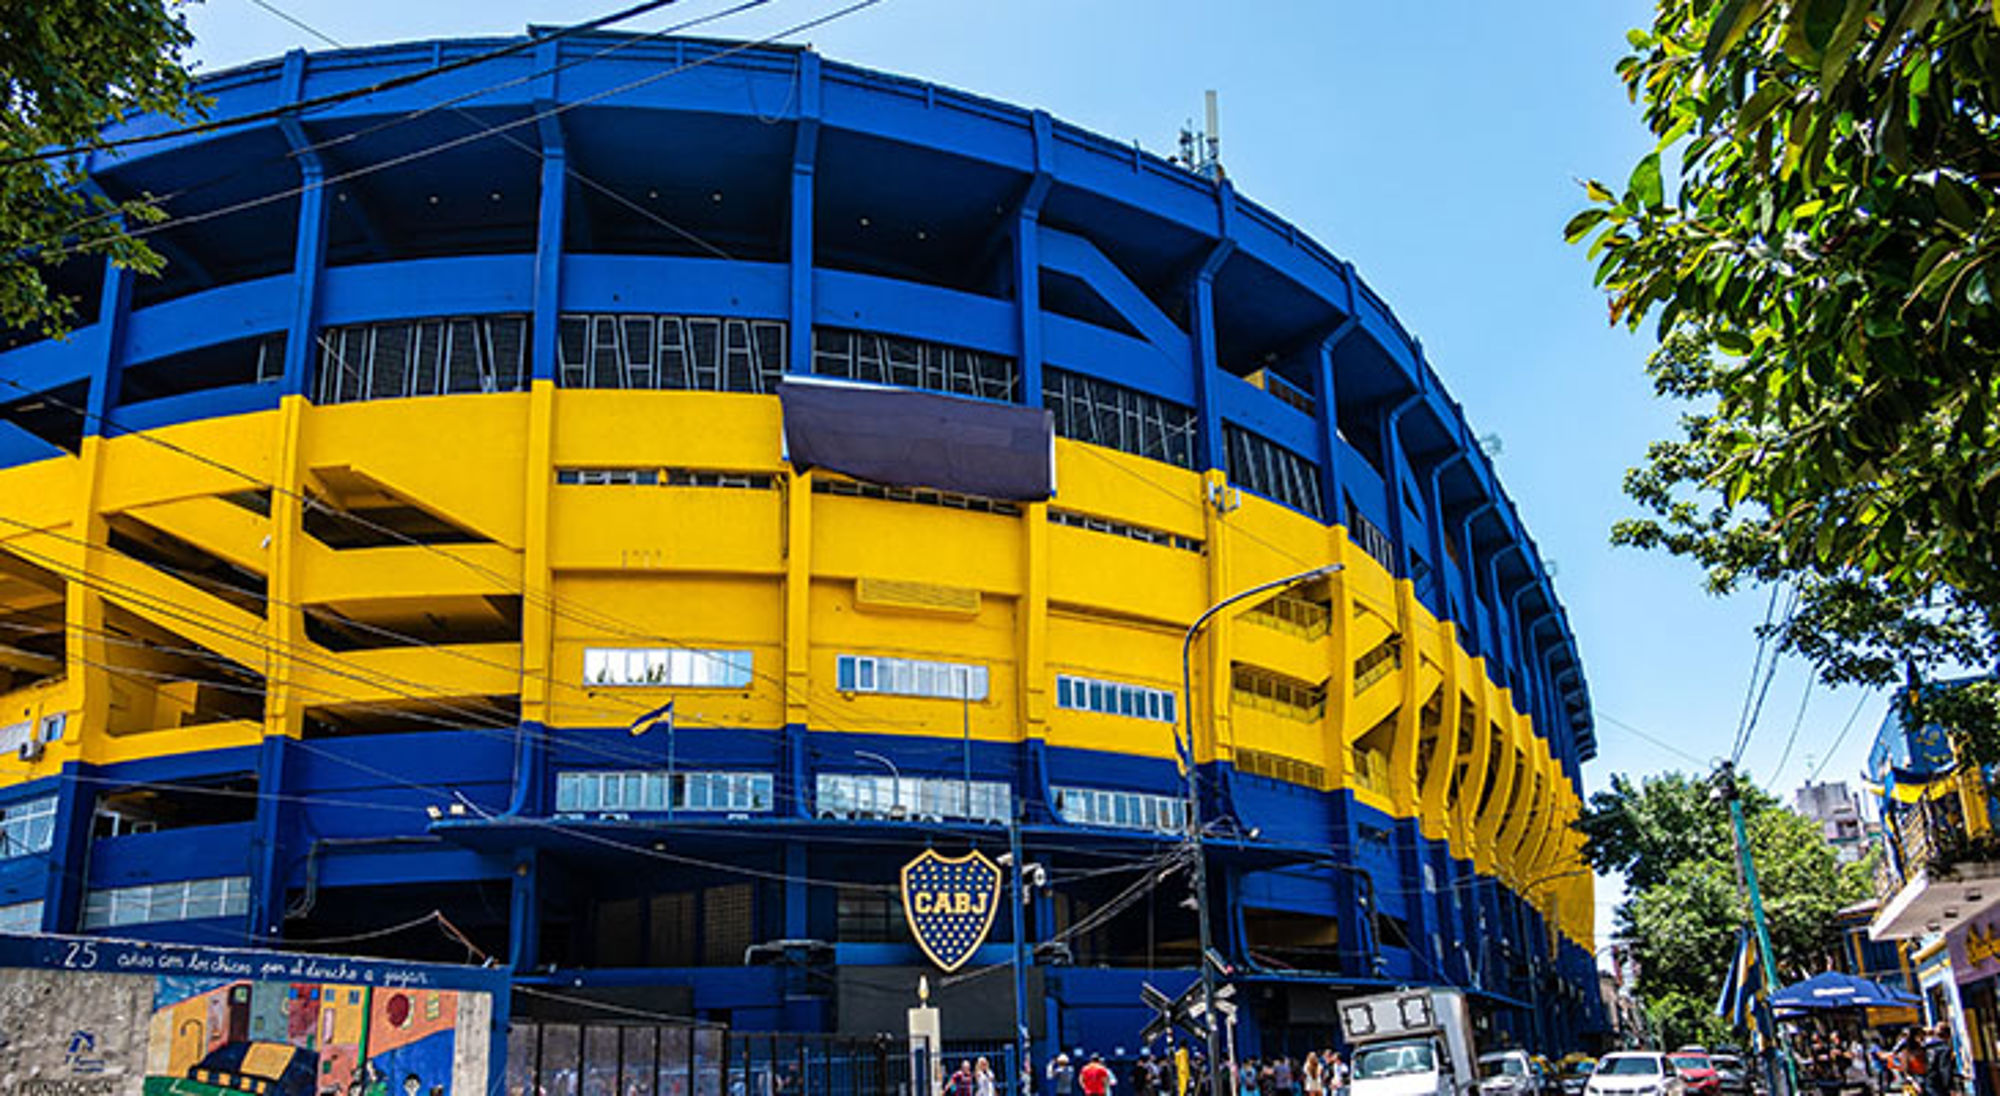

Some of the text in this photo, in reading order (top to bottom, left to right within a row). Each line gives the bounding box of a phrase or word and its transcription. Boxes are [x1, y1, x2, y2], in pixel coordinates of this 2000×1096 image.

[914, 892, 988, 914] CABJ
[65, 942, 97, 968] 25
[211, 955, 251, 975] chicos
